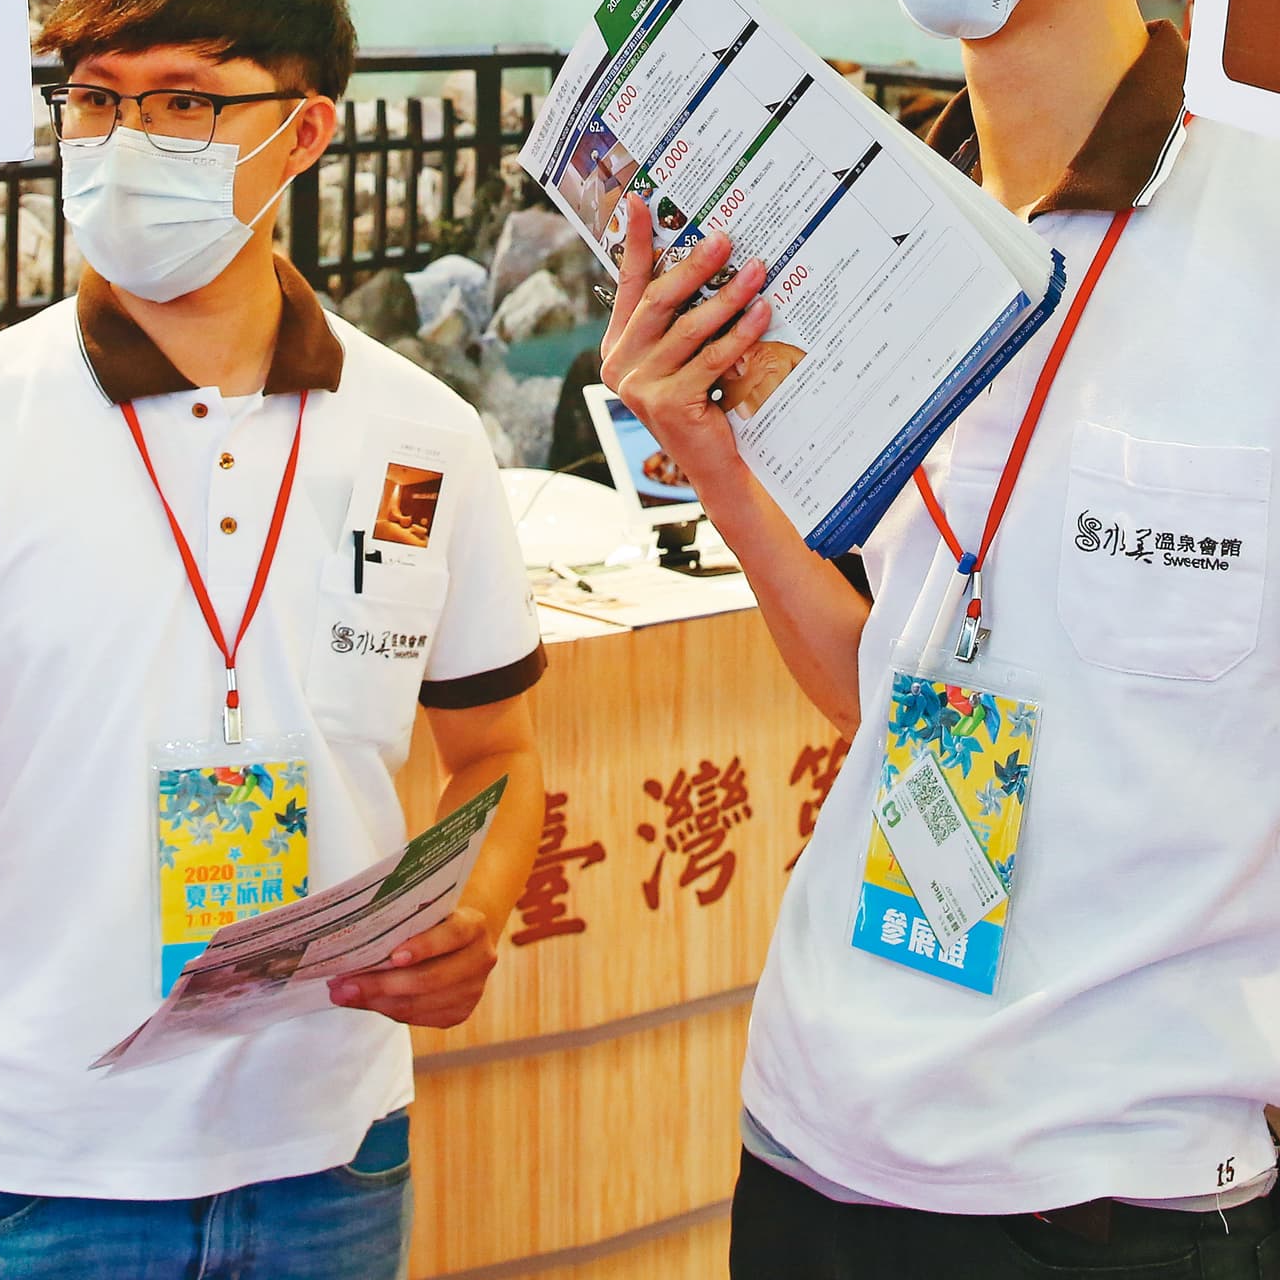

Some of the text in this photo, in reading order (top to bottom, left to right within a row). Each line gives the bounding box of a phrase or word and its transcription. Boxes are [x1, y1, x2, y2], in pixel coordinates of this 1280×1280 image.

[1163, 552, 1229, 571] SweetMe
[185, 864, 234, 883] 2020
[185, 878, 283, 909] 夏季旅展
[1217, 1157, 1235, 1187] 15
